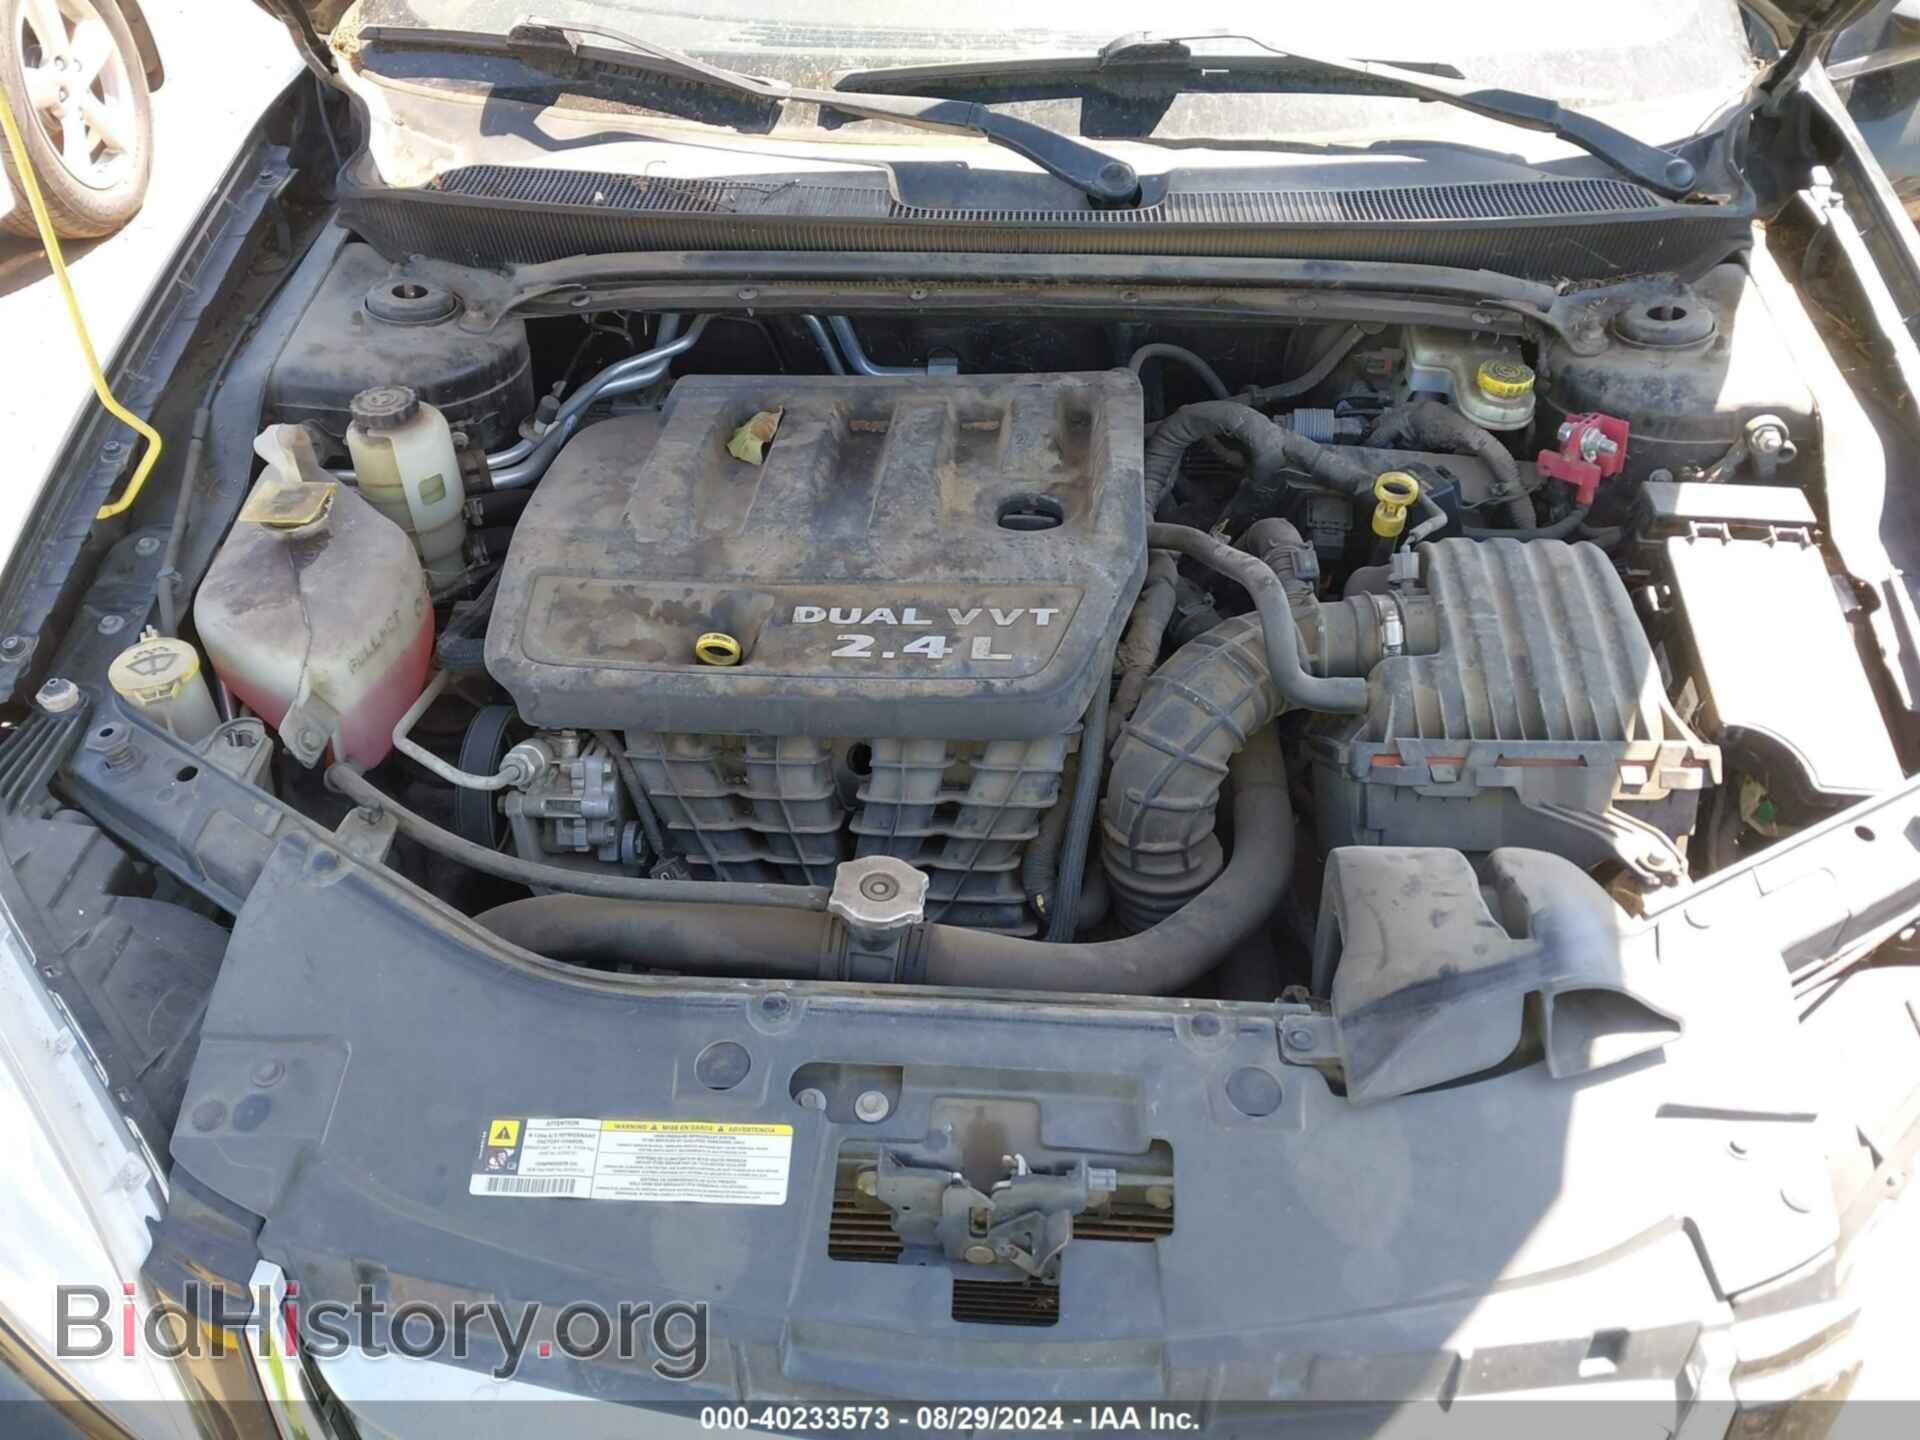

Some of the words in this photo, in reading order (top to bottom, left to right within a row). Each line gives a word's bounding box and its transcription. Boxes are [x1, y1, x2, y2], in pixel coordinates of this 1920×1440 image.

[792, 606, 933, 625] DUAL
[947, 608, 1060, 627] VVT
[831, 634, 953, 660] 2.4
[971, 636, 1013, 661] L
